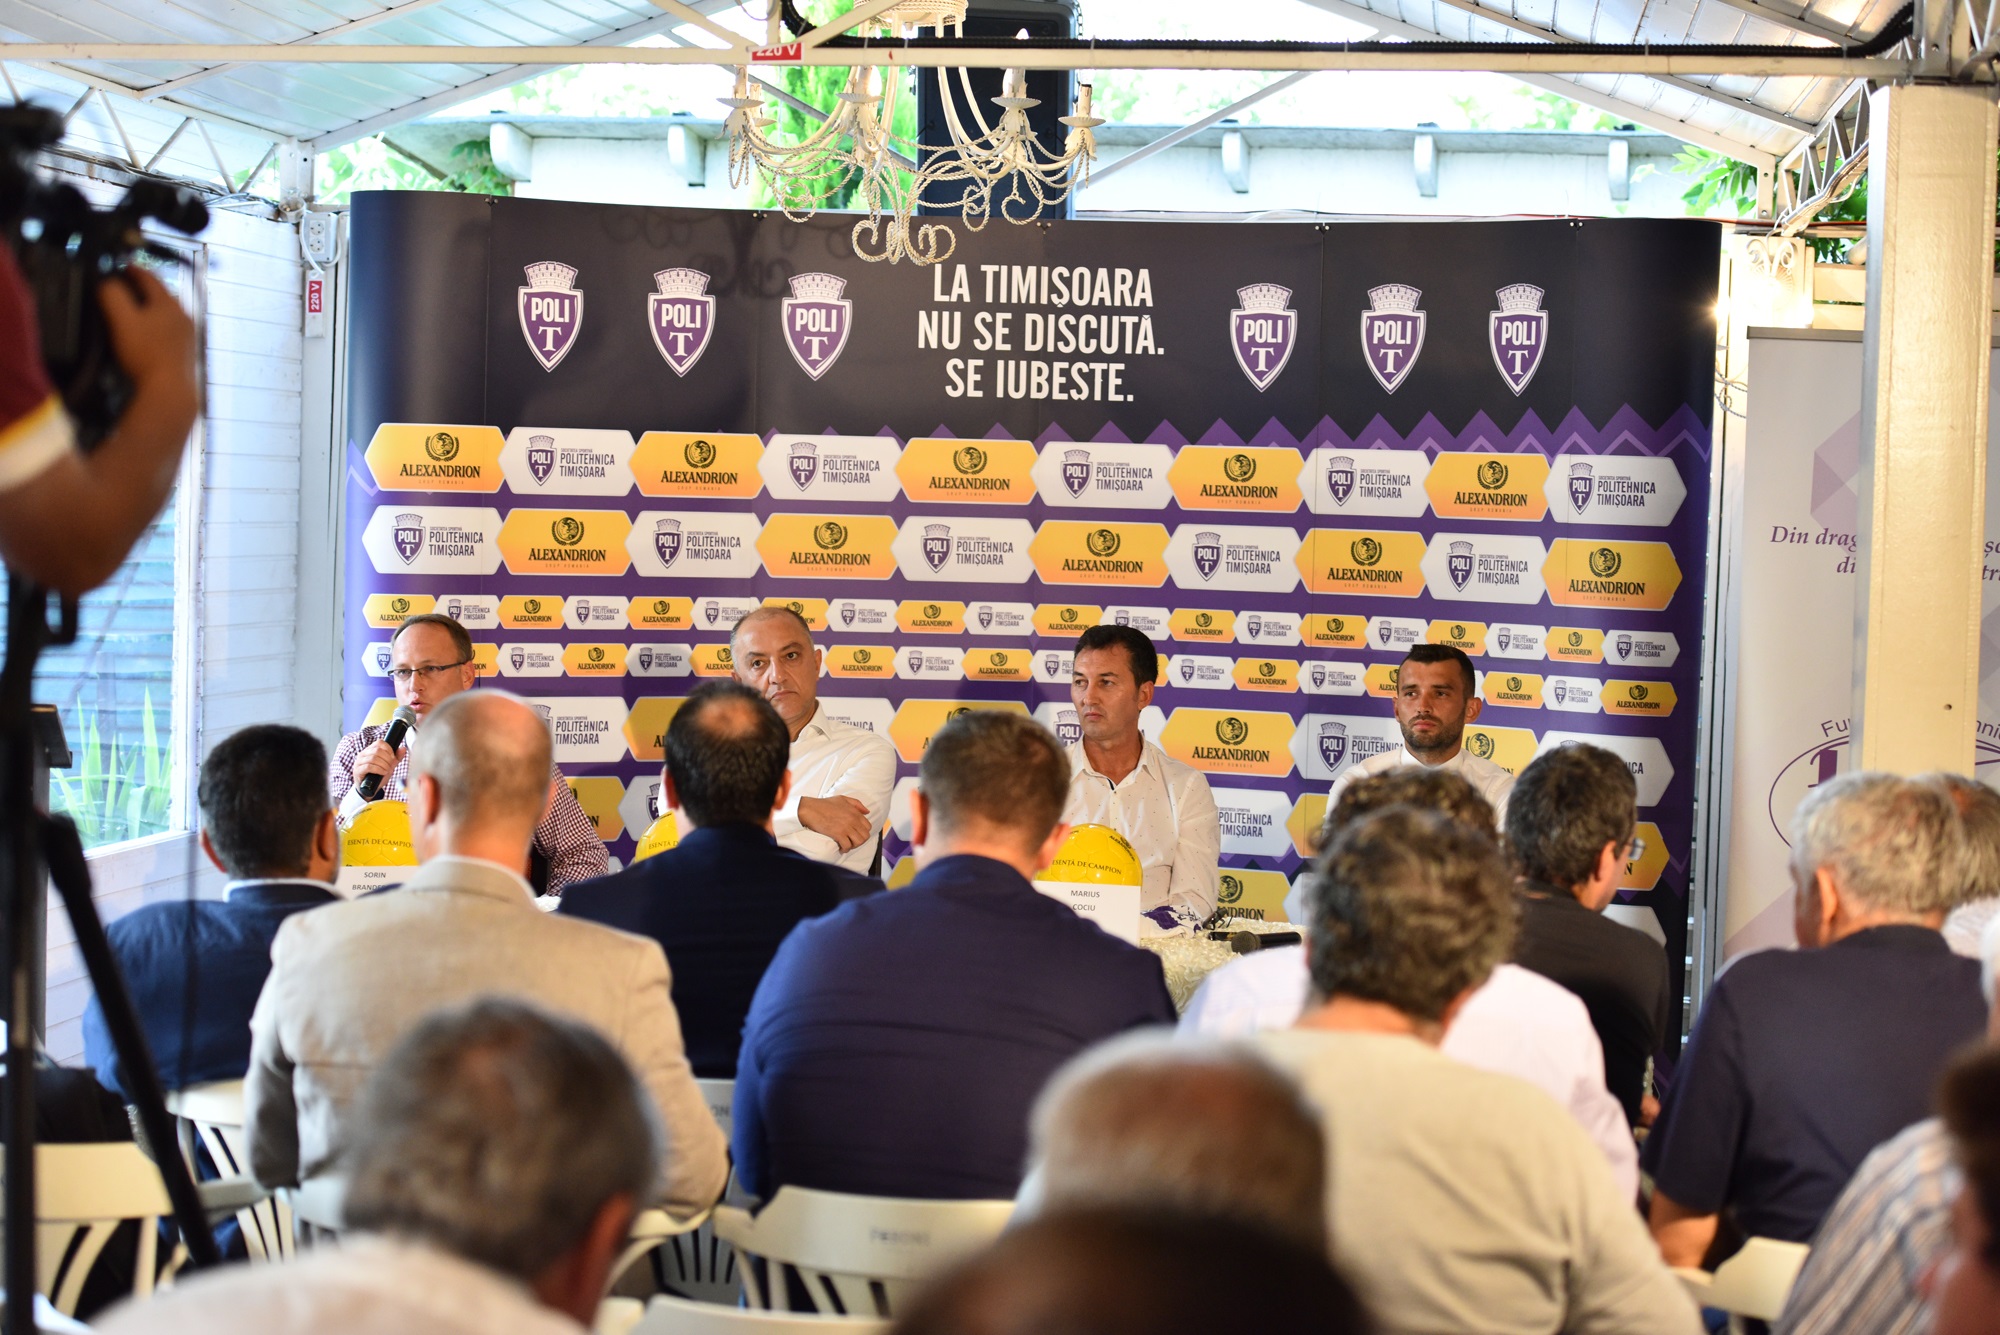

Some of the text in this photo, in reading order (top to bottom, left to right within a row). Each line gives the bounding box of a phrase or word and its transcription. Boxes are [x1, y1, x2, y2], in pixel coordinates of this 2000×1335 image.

[787, 43, 798, 56] V
[934, 263, 971, 303] LA
[310, 283, 320, 310] 220 V
[531, 297, 569, 323] POLI
[661, 303, 701, 329] POLI
[795, 308, 837, 333] POLI
[917, 310, 962, 350] NU
[973, 311, 1012, 351] SE
[1243, 319, 1283, 343] POLI
[1373, 320, 1412, 345] POLI
[1501, 321, 1536, 346] POLI
[538, 326, 562, 352] T
[669, 332, 693, 357] T
[803, 336, 828, 360] T
[1250, 347, 1275, 372] T
[1379, 348, 1403, 374] T
[1508, 350, 1529, 375] T
[945, 358, 984, 398] SE
[531, 451, 550, 464] POLI
[560, 453, 615, 466] POLITEHNICA
[793, 458, 813, 470] POLI
[400, 463, 481, 479] ALEXANDRION
[534, 465, 547, 478] T
[823, 459, 880, 472] POLITEHNICA
[1066, 465, 1087, 478] POLI
[661, 470, 738, 485] ALEXANDRION
[796, 471, 809, 484] T
[1096, 466, 1153, 479] POLITEHNICA
[1331, 472, 1351, 485] POLI
[929, 476, 1010, 491] ALEXANDRION
[1070, 478, 1082, 491] T
[1360, 473, 1411, 487] POLITEHNICA
[1572, 479, 1589, 492] POLI
[1200, 484, 1278, 499] ALEXANDRION
[1335, 486, 1347, 499] T
[1598, 481, 1656, 494] POLITEHNICA
[1454, 491, 1527, 507] ALEXANDRION
[1575, 493, 1586, 507] T
[397, 530, 419, 543] POLI
[429, 531, 484, 544] POLITEHNICA
[658, 535, 677, 547] POLI
[1770, 525, 1809, 544] Din
[686, 535, 741, 548] POLITEHNICA
[926, 540, 947, 553] POLI
[956, 541, 1014, 554] POLITEHNICA
[401, 543, 415, 557] T
[528, 548, 606, 562] ALEXANDRION
[661, 547, 674, 560] T
[1197, 547, 1217, 560] POLI
[1226, 549, 1281, 562] POLITEHNICA
[789, 551, 871, 566] ALEXANDRION
[930, 553, 943, 565] T
[1451, 558, 1469, 570] POLI
[1062, 558, 1143, 573] ALEXANDRION
[1200, 560, 1213, 573] T
[1478, 559, 1529, 573] POLITEHNICA
[1327, 567, 1403, 583] ALEXANDRION
[1454, 571, 1466, 584] T
[1568, 578, 1645, 595] ALEXANDRION
[911, 619, 953, 627] ALEXANDRION
[1315, 633, 1355, 641] ALEXANDRION
[1558, 647, 1592, 656] ALEXANDRION
[841, 664, 883, 672] ALEXANDRION
[978, 667, 1019, 675] ALEXANDRION
[1247, 677, 1287, 685] ALEXANDRION
[1496, 691, 1532, 700] ALEXANDRION
[1616, 700, 1660, 709] ALEXANDRION
[556, 720, 609, 733] POLITEHNICA
[1059, 726, 1079, 738] POLI
[1323, 738, 1342, 751] POLI
[1192, 746, 1270, 763] ALEXANDRION
[1326, 751, 1338, 764] T
[1218, 811, 1273, 826] POLITEHNICA
[382, 840, 414, 849] CAMPIO
[1088, 863, 1122, 875] CAMPION
[1070, 890, 1101, 898] MARIUS
